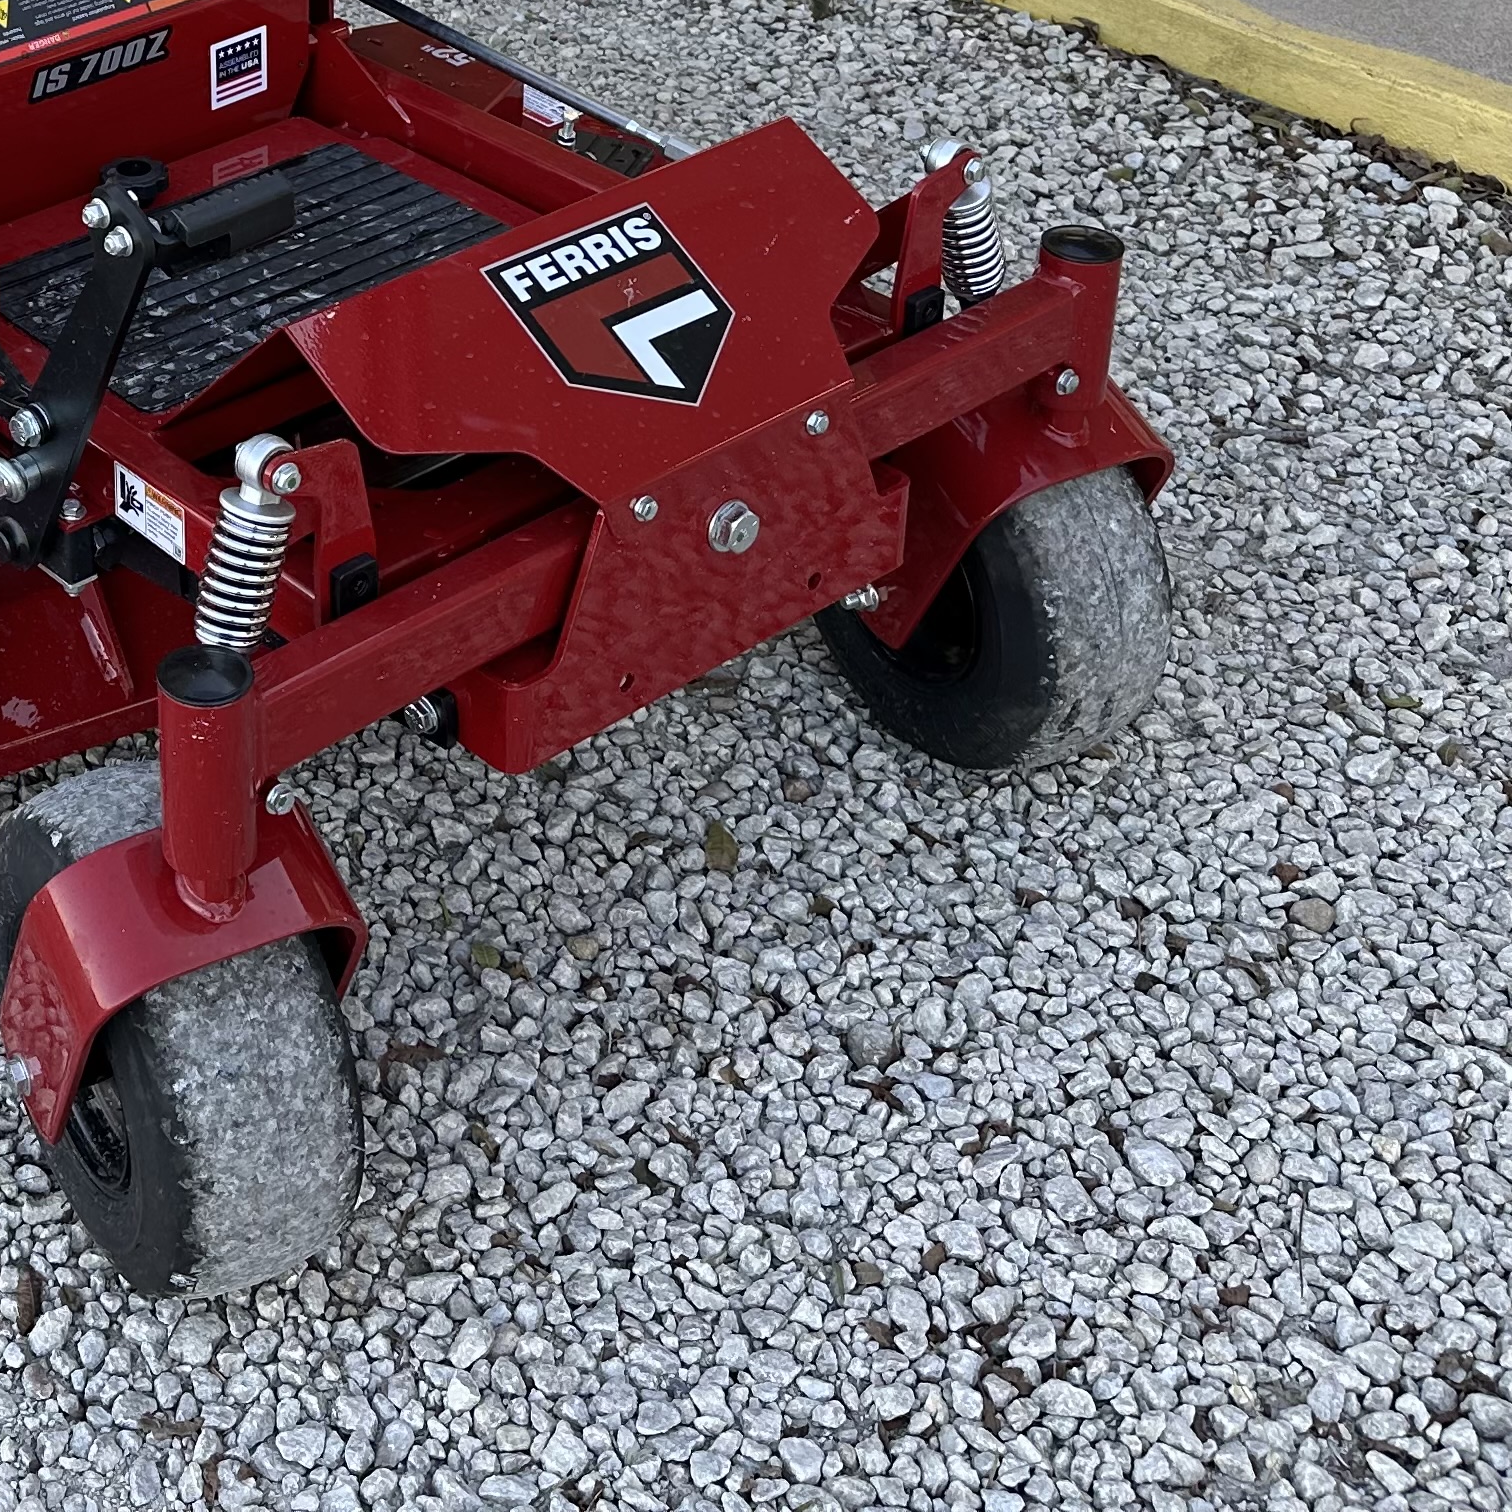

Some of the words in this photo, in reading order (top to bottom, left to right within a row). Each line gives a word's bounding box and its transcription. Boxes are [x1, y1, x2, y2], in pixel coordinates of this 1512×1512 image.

[27, 33, 61, 51] DANGER
[32, 63, 71, 100] IS
[76, 29, 171, 91] 700Z
[219, 49, 259, 69] ASSEMBLED
[219, 70, 226, 78] IN
[228, 66, 240, 75] THE
[241, 58, 259, 70] USA
[499, 216, 662, 303] FERRIS
